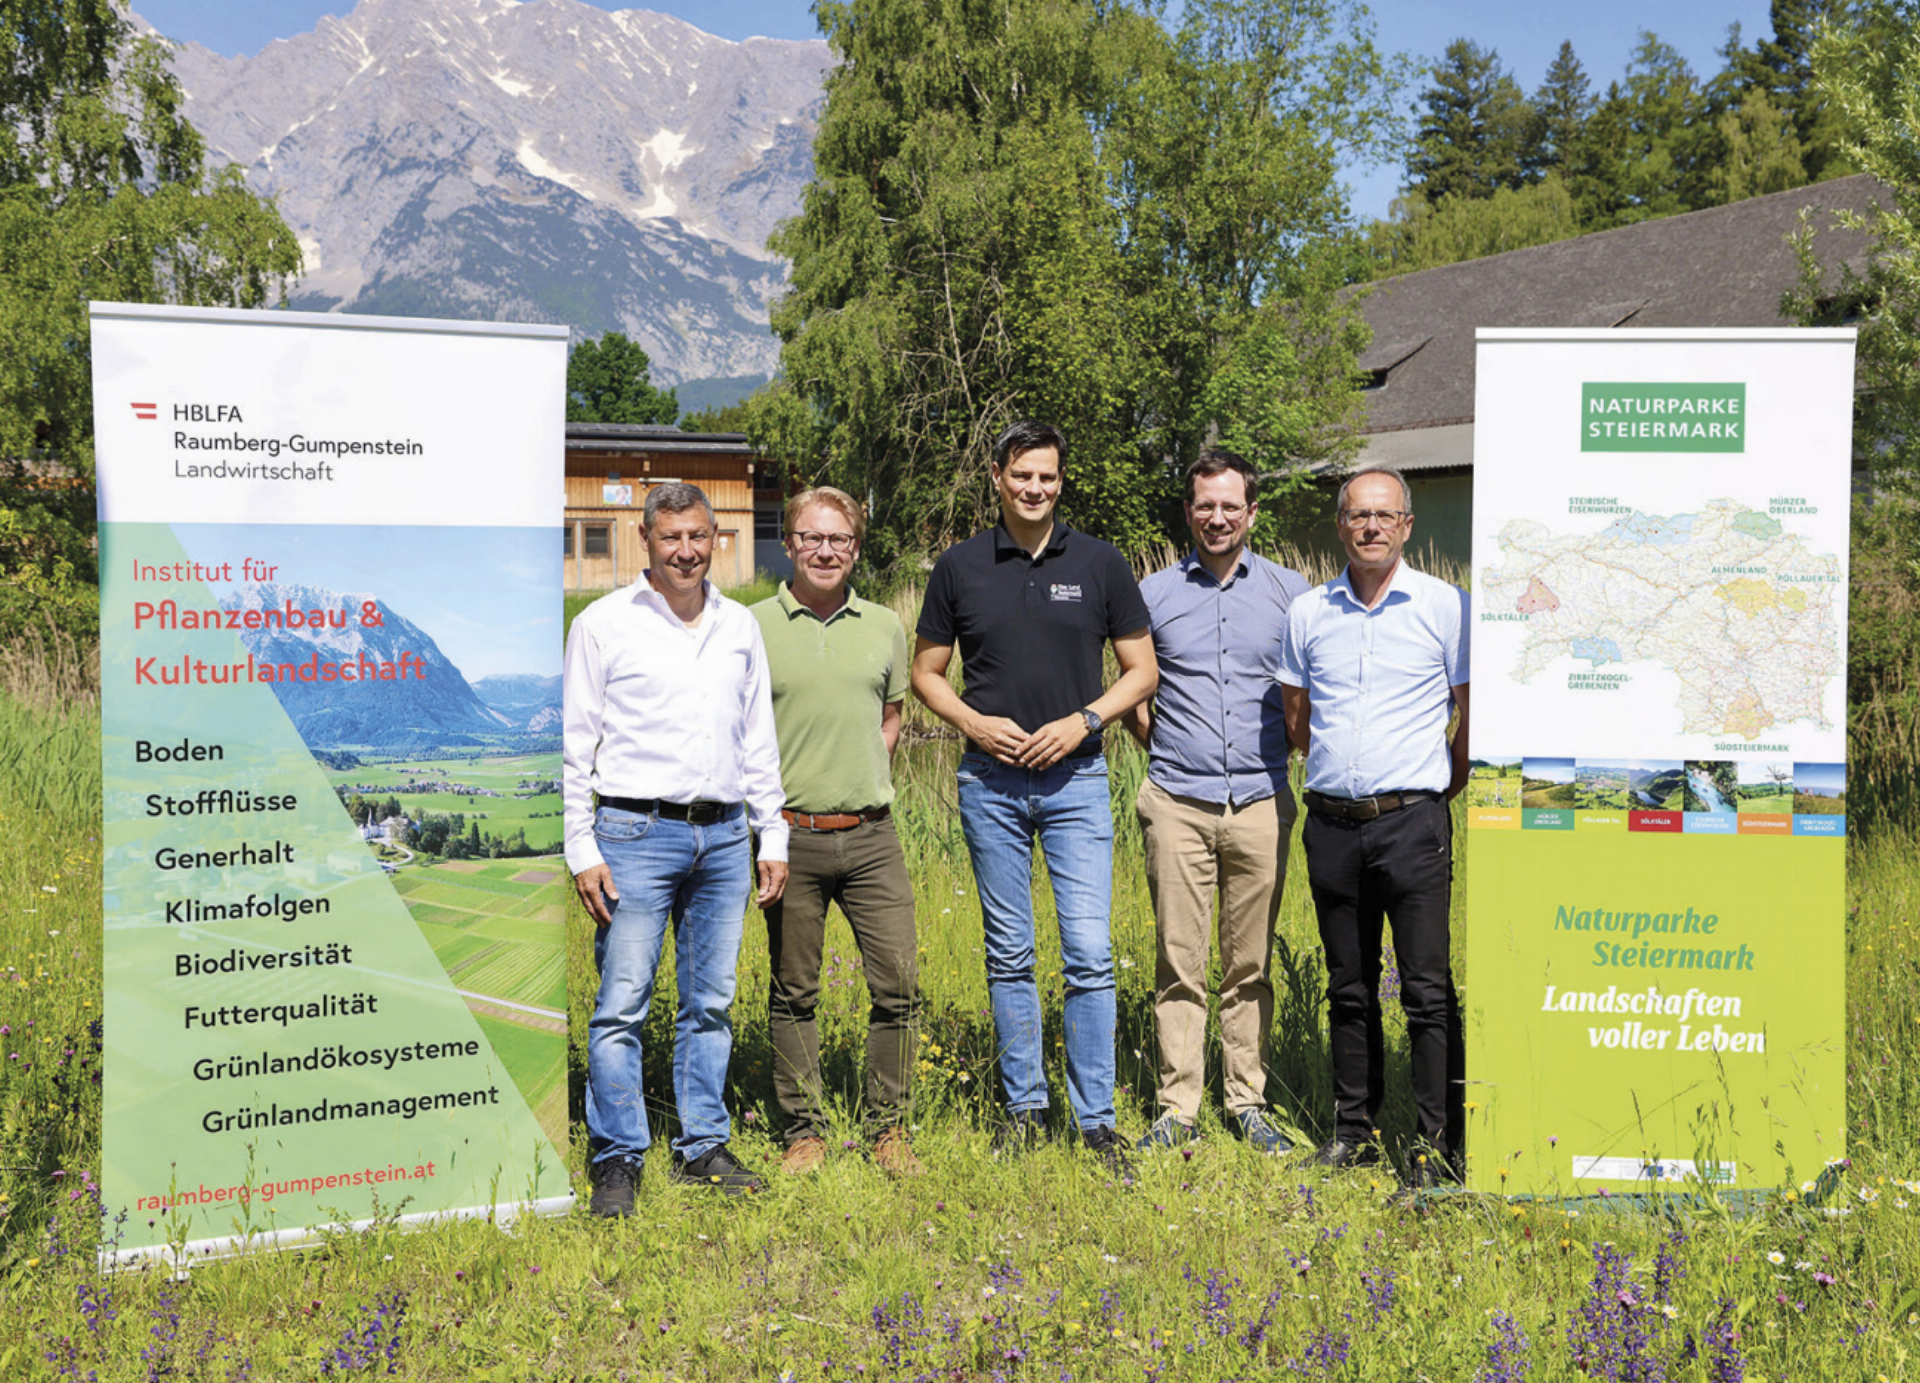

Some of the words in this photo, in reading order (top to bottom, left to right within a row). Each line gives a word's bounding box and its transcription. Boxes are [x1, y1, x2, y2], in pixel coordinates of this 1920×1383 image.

[173, 403, 243, 424] HBLFA
[1589, 398, 1740, 414] NATURPARKE
[1588, 422, 1739, 438] STEIERMARK
[174, 431, 424, 458] Raumberg-Gumpenstein
[174, 459, 335, 481] Landwirtschaft
[1568, 497, 1619, 506] STEIRISCHE
[1568, 506, 1632, 514] EISENWURZEN
[1769, 497, 1807, 506] MÜRZER
[1769, 507, 1818, 515] OBERLAND
[133, 558, 233, 582] Institut
[241, 557, 279, 582] für
[1711, 566, 1768, 575] ALMENLAND
[1777, 573, 1824, 583] PÖLLAUER
[1826, 575, 1841, 584] TAL
[134, 599, 348, 630] Pflanzenbau
[360, 600, 385, 628] &
[1480, 612, 1530, 622] SÖLKTÄLER
[135, 650, 428, 685] Kulturlandschaft
[1568, 682, 1619, 690] GREBENZEN
[135, 738, 224, 763] Boden
[1714, 742, 1790, 753] SÜDSTEIERMARK
[146, 789, 298, 817] Stoffflüsse
[155, 840, 295, 870] Generhalt
[165, 893, 331, 924] Klimafolgen
[1554, 905, 1719, 939] Naturparke
[175, 943, 353, 977] Biodiversität
[1592, 941, 1755, 971] Steiermark
[184, 994, 378, 1030] Futterqualität
[1541, 986, 1742, 1022] Landschaften
[1588, 1022, 1671, 1050] voller
[1676, 1024, 1765, 1053] Leben
[192, 1039, 480, 1082] Grünlandökosysteme
[201, 1085, 500, 1134] Grünlandmanagement
[136, 1160, 437, 1212] raumberg-gumpenstein.at
